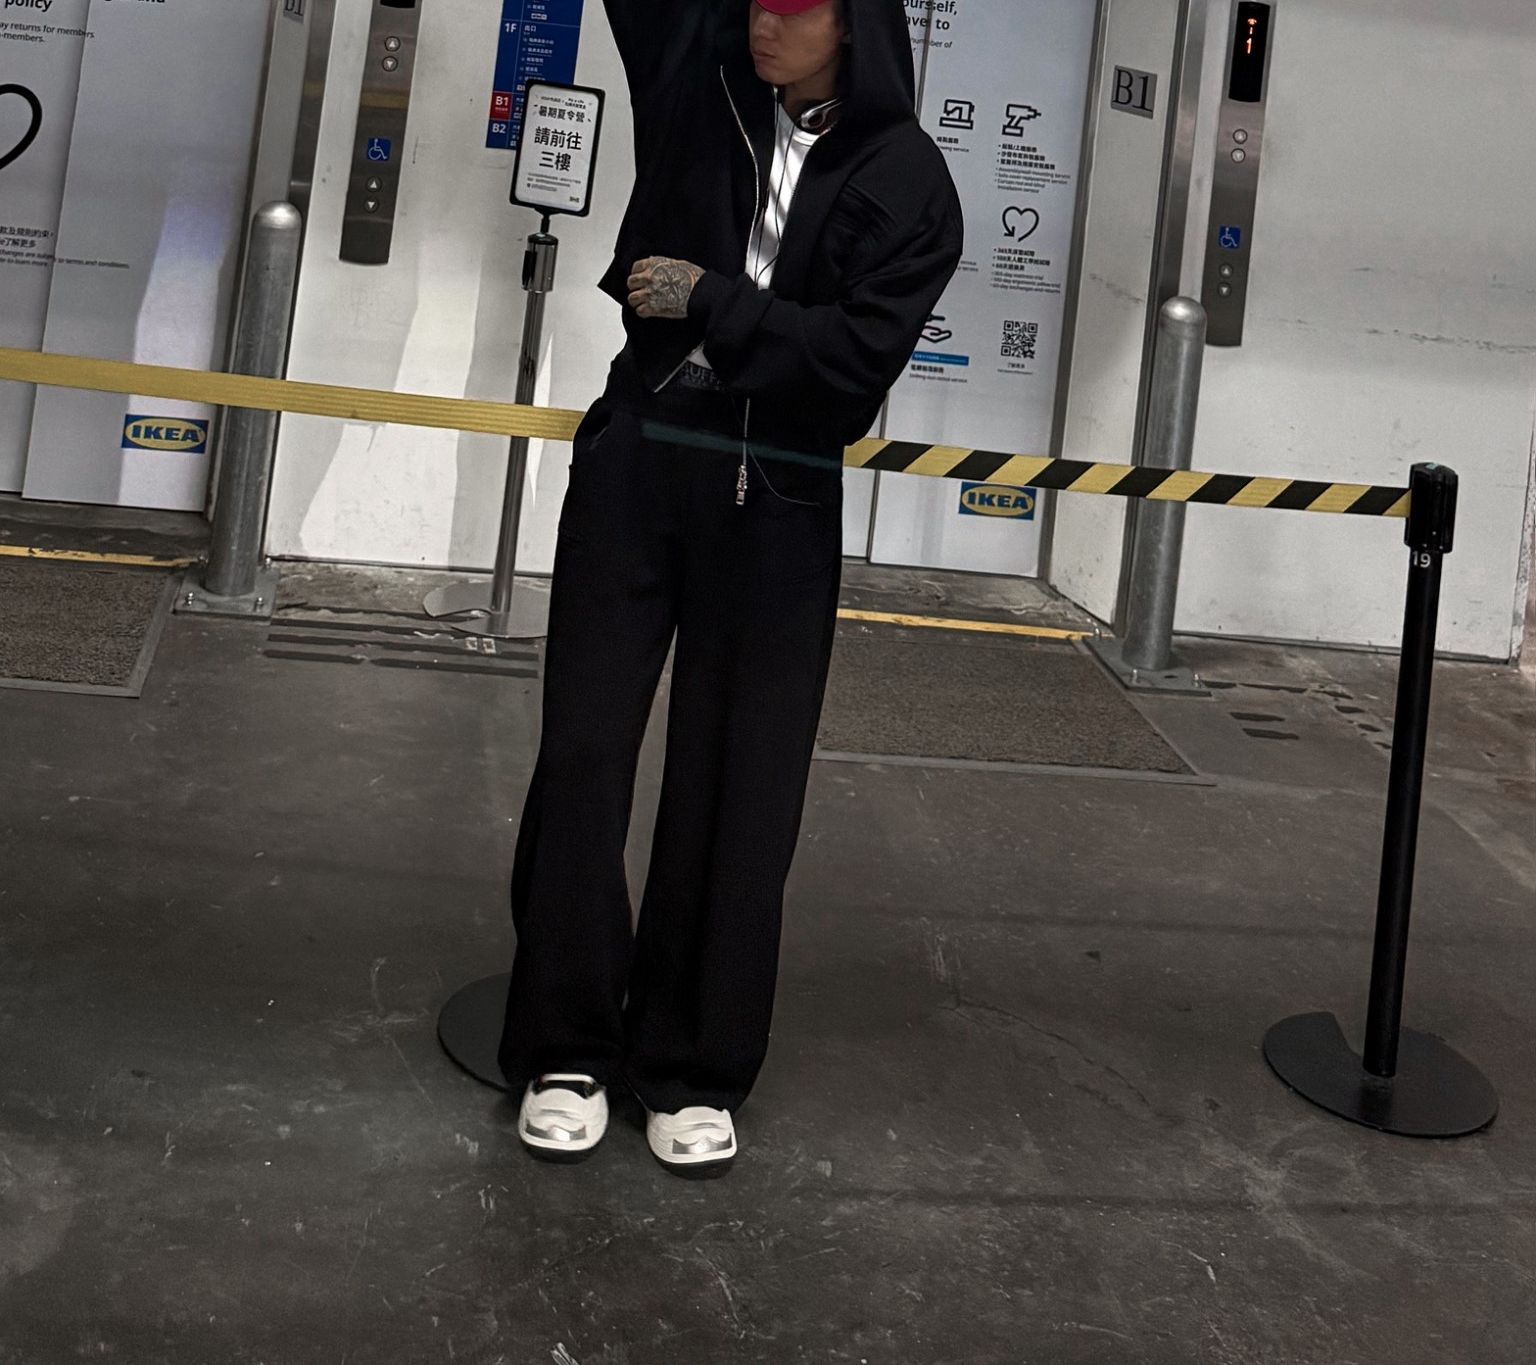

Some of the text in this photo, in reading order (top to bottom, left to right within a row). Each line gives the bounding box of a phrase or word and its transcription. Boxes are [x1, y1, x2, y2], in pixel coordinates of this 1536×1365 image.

[10, 22, 42, 33] returns
[43, 25, 55, 34] for
[504, 22, 517, 33] 1F
[935, 18, 951, 31] to
[944, 41, 953, 49] of
[1246, 37, 1253, 54] 1
[1111, 68, 1154, 113] B1
[495, 96, 509, 106] B1
[492, 123, 506, 134] B2
[534, 126, 582, 151] 請前往
[539, 151, 571, 172] 三樓
[132, 424, 201, 443] IKEA
[966, 491, 1029, 510] IKEA
[1412, 550, 1431, 568] 19
